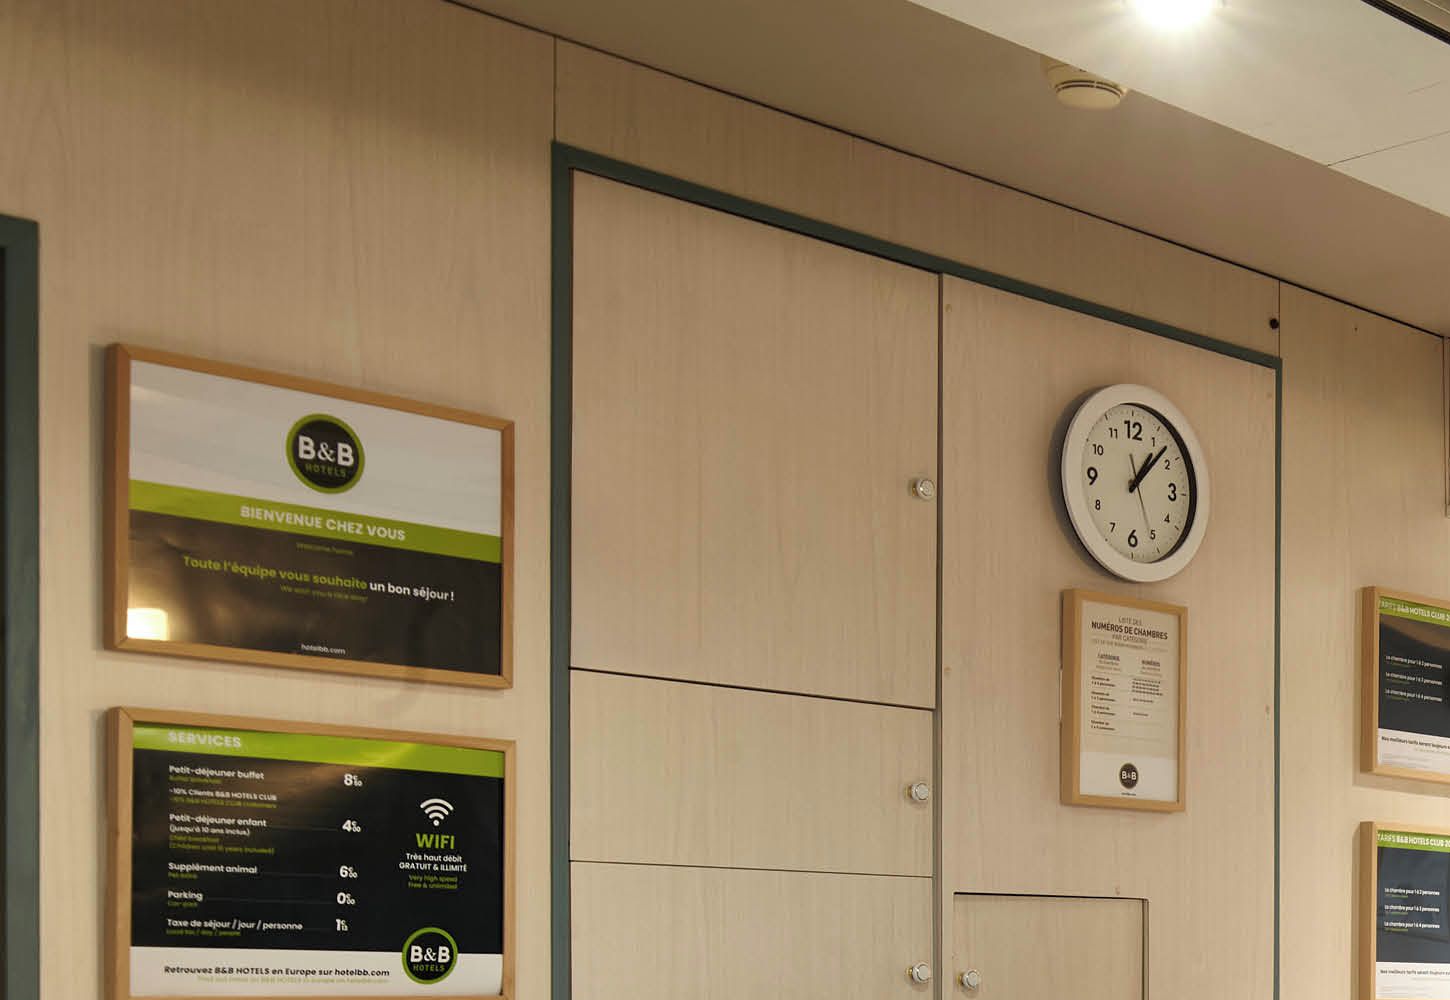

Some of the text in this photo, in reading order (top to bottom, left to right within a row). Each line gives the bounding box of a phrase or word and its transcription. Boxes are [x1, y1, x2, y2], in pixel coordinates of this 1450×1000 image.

[1109, 427, 1118, 439] 11
[1124, 420, 1142, 441] 12
[1151, 437, 1155, 447] 1
[298, 435, 354, 467] B&B
[1092, 444, 1104, 456] 10
[305, 463, 346, 477] HOTELS
[1164, 459, 1170, 470] 2
[1087, 467, 1098, 485] 9
[1167, 483, 1177, 502] 3
[1095, 499, 1101, 510] 8
[240, 505, 406, 542] BIENVENUE CHEZ VOUS
[1164, 513, 1170, 523] 4
[1109, 522, 1116, 533] 7
[1127, 529, 1138, 548] 6
[1150, 530, 1156, 540] 5
[184, 556, 220, 571] Toute
[223, 560, 277, 580] l'équipe
[279, 571, 310, 582] vous
[312, 575, 368, 590] souhaite
[369, 582, 386, 593] un
[387, 582, 411, 596] bon
[1409, 607, 1431, 618] HOTELS
[1124, 626, 1133, 635] DE
[1134, 627, 1168, 640] CHAMBRES
[167, 730, 242, 748] SERVICES
[169, 765, 265, 780] Petit-déjeuner buffet
[231, 791, 258, 801] HOTELS
[259, 793, 277, 801] CLUB
[169, 813, 267, 828] Petit-déjeuner enfant
[415, 832, 455, 849] WIFI
[1409, 836, 1430, 846] HOTELS
[406, 852, 463, 863] Très haut débit
[168, 862, 258, 875] Supplément animal
[399, 862, 432, 871] GRATUIT
[432, 863, 440, 872] &
[167, 890, 203, 902] Parking
[167, 919, 188, 928] Taxe
[190, 919, 202, 928] de
[204, 919, 231, 931] séjour
[238, 919, 256, 931] jour
[262, 923, 303, 932] personne
[410, 945, 450, 963] B&B
[164, 966, 213, 974] Retrouvez
[214, 966, 233, 974] B&B
[236, 967, 269, 975] HOTELS
[285, 968, 316, 978] Europe
[334, 968, 390, 977] hotelbb.com
